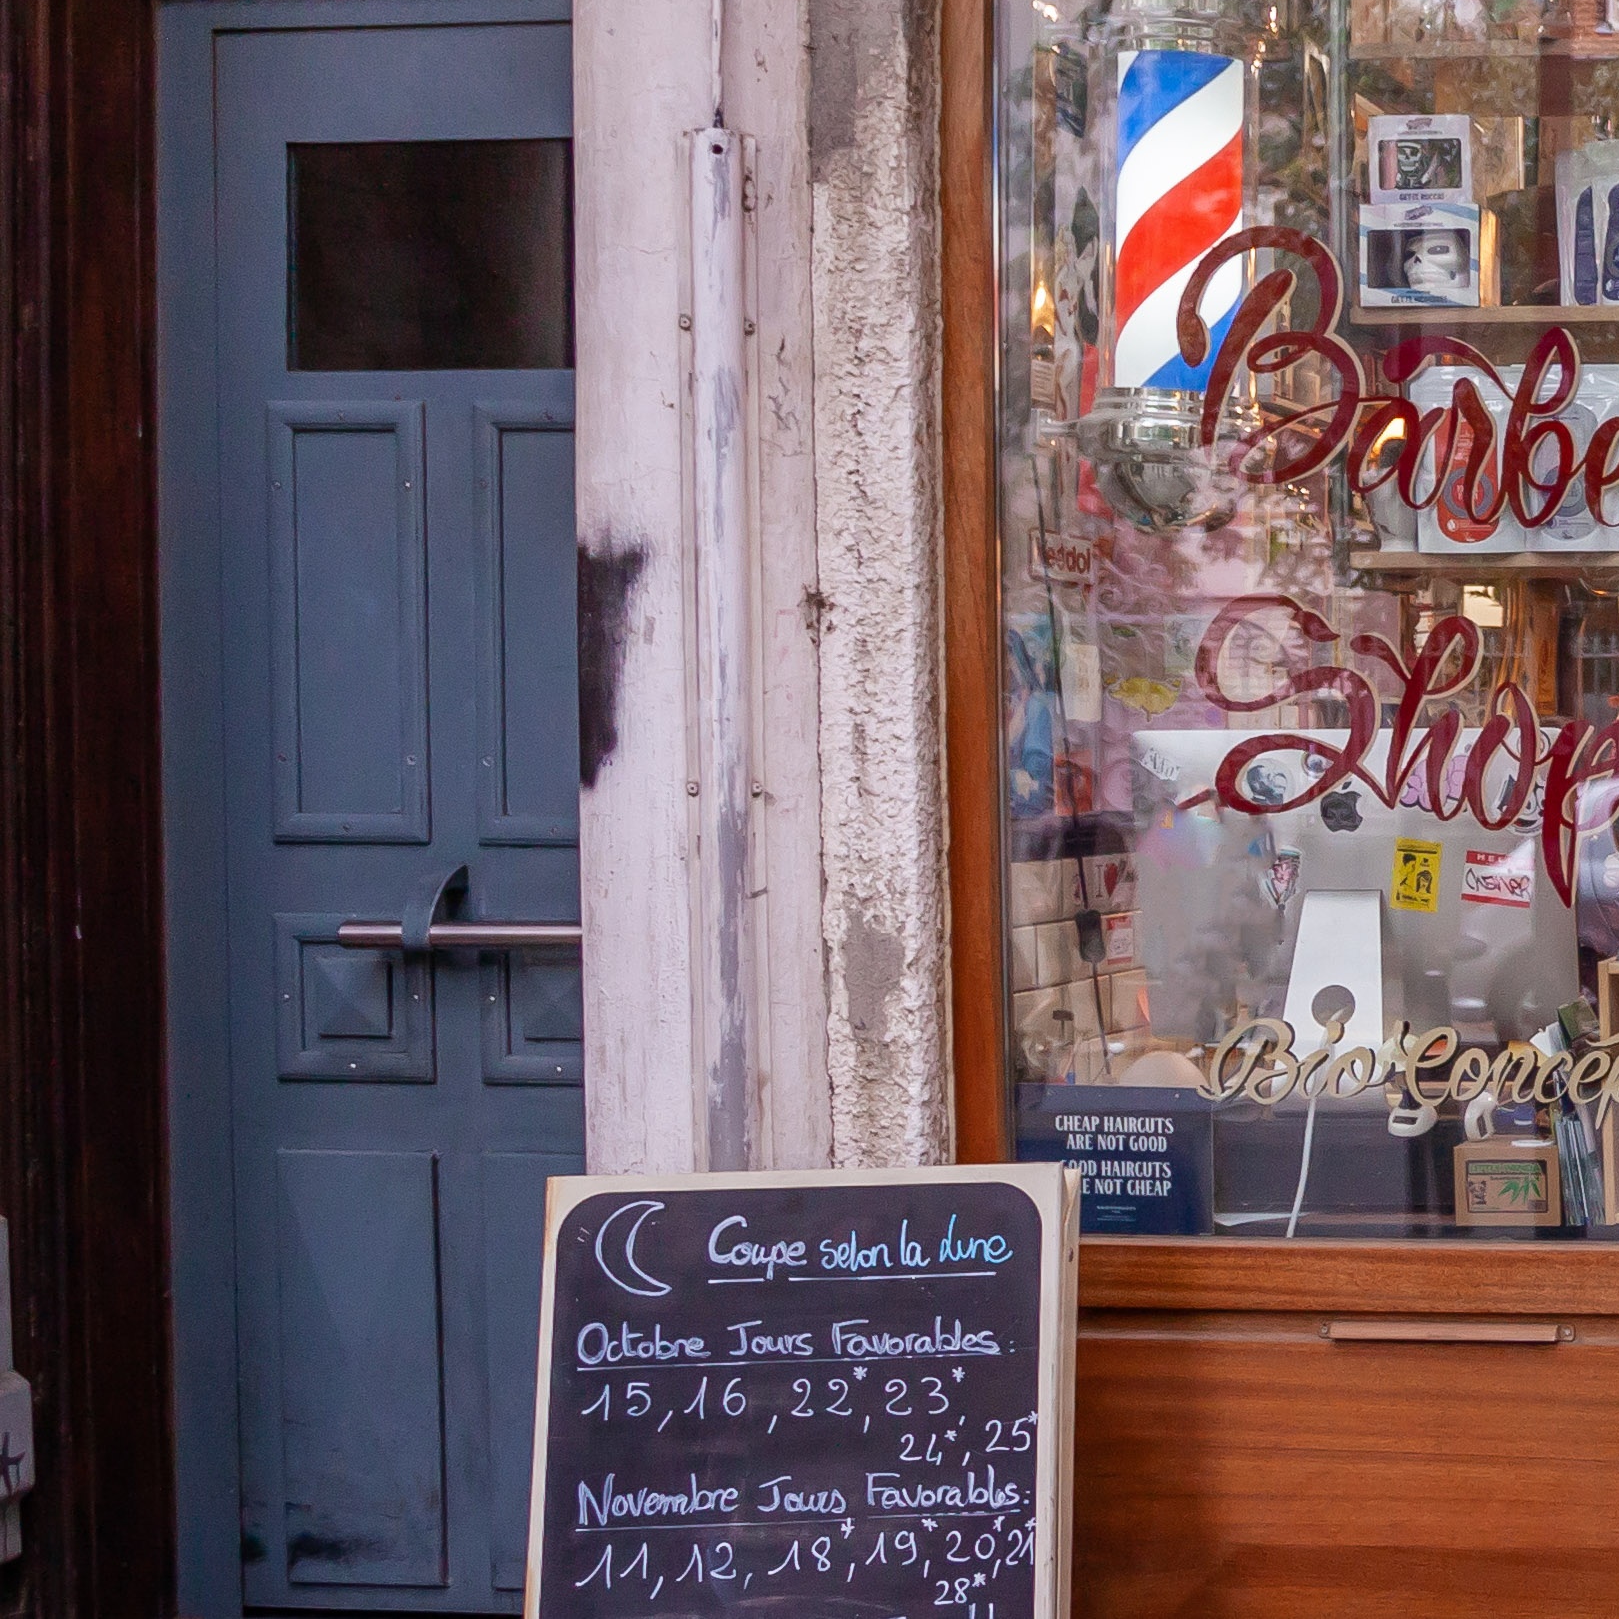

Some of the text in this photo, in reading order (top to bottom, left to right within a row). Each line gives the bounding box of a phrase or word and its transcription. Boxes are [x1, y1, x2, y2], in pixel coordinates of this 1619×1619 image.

[1055, 1115, 1174, 1134] CHEAP HAIRCUTS
[1066, 1133, 1167, 1152] ARE NOT GOOD
[1101, 1161, 1172, 1178] HAIRCUTS
[1095, 1179, 1124, 1195] NOT
[1127, 1180, 1172, 1197] CHEAP
[708, 1215, 807, 1280] Coupe
[820, 1231, 893, 1272] selon
[899, 1220, 930, 1267] la
[576, 1321, 711, 1361] Octobre
[727, 1320, 813, 1356] Jours
[577, 1472, 739, 1526] Novembre
[757, 1475, 848, 1514] Jours
